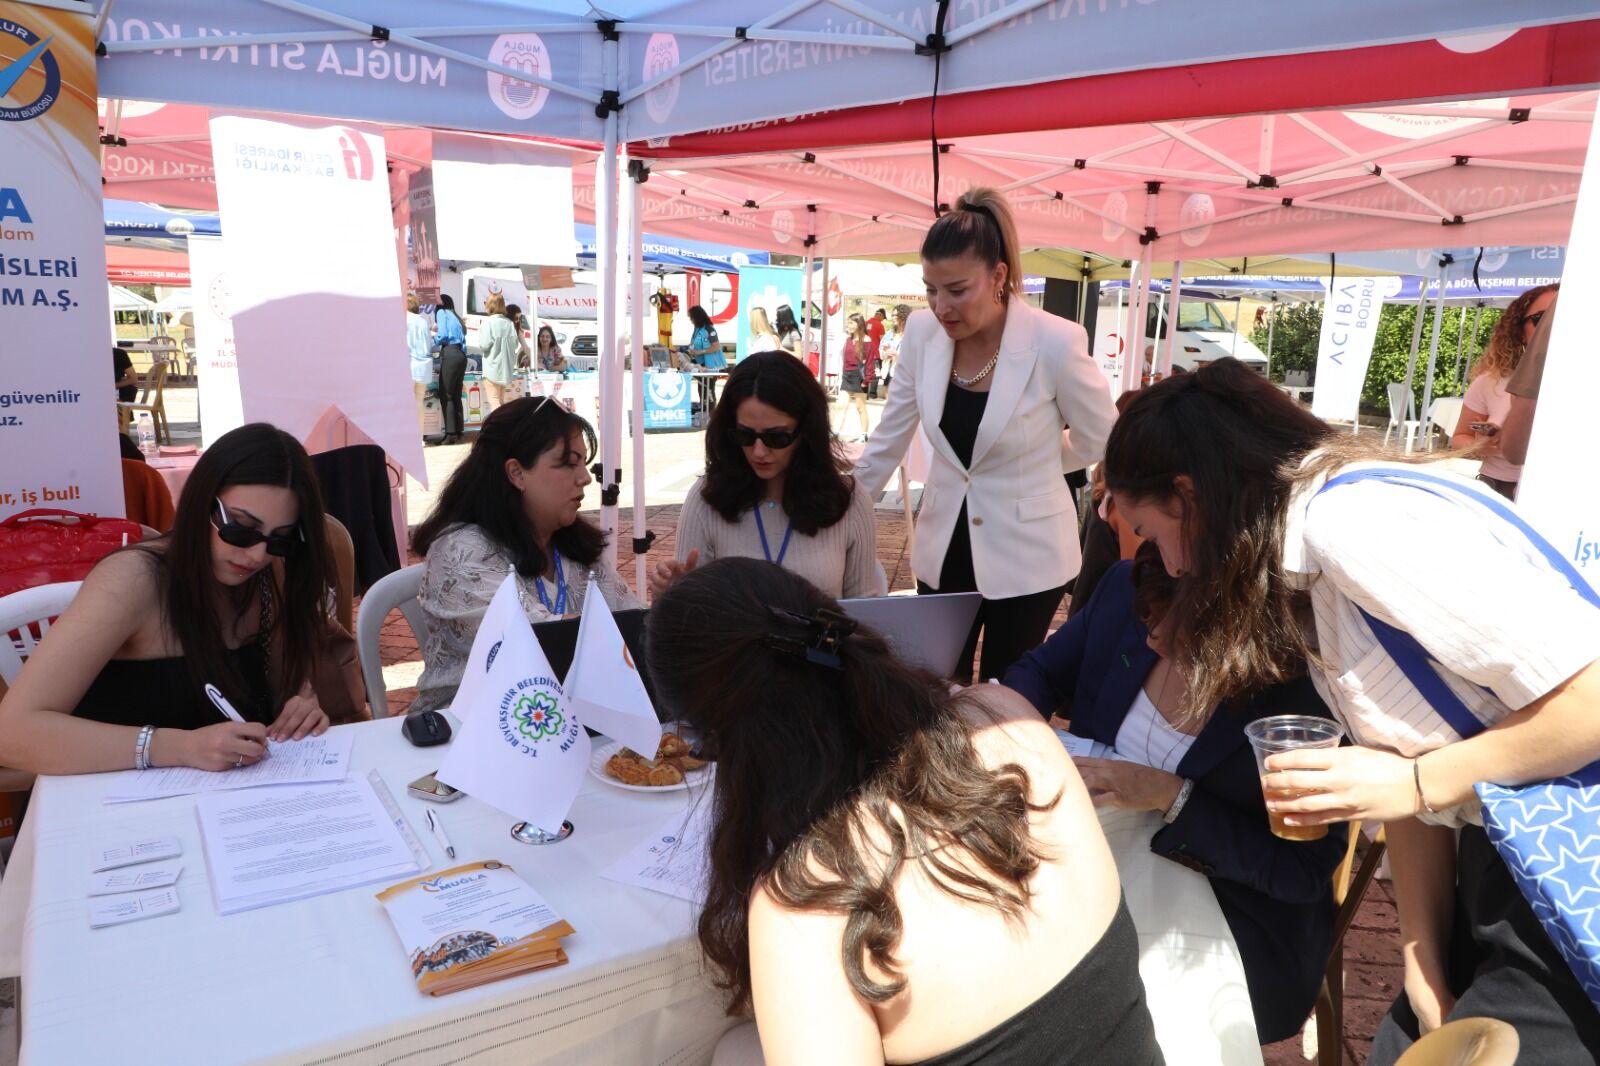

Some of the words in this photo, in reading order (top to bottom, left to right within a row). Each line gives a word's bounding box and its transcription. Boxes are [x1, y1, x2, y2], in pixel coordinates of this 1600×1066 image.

[0, 21, 29, 39] UR
[22, 489, 38, 506] iş
[42, 486, 80, 502] bul!
